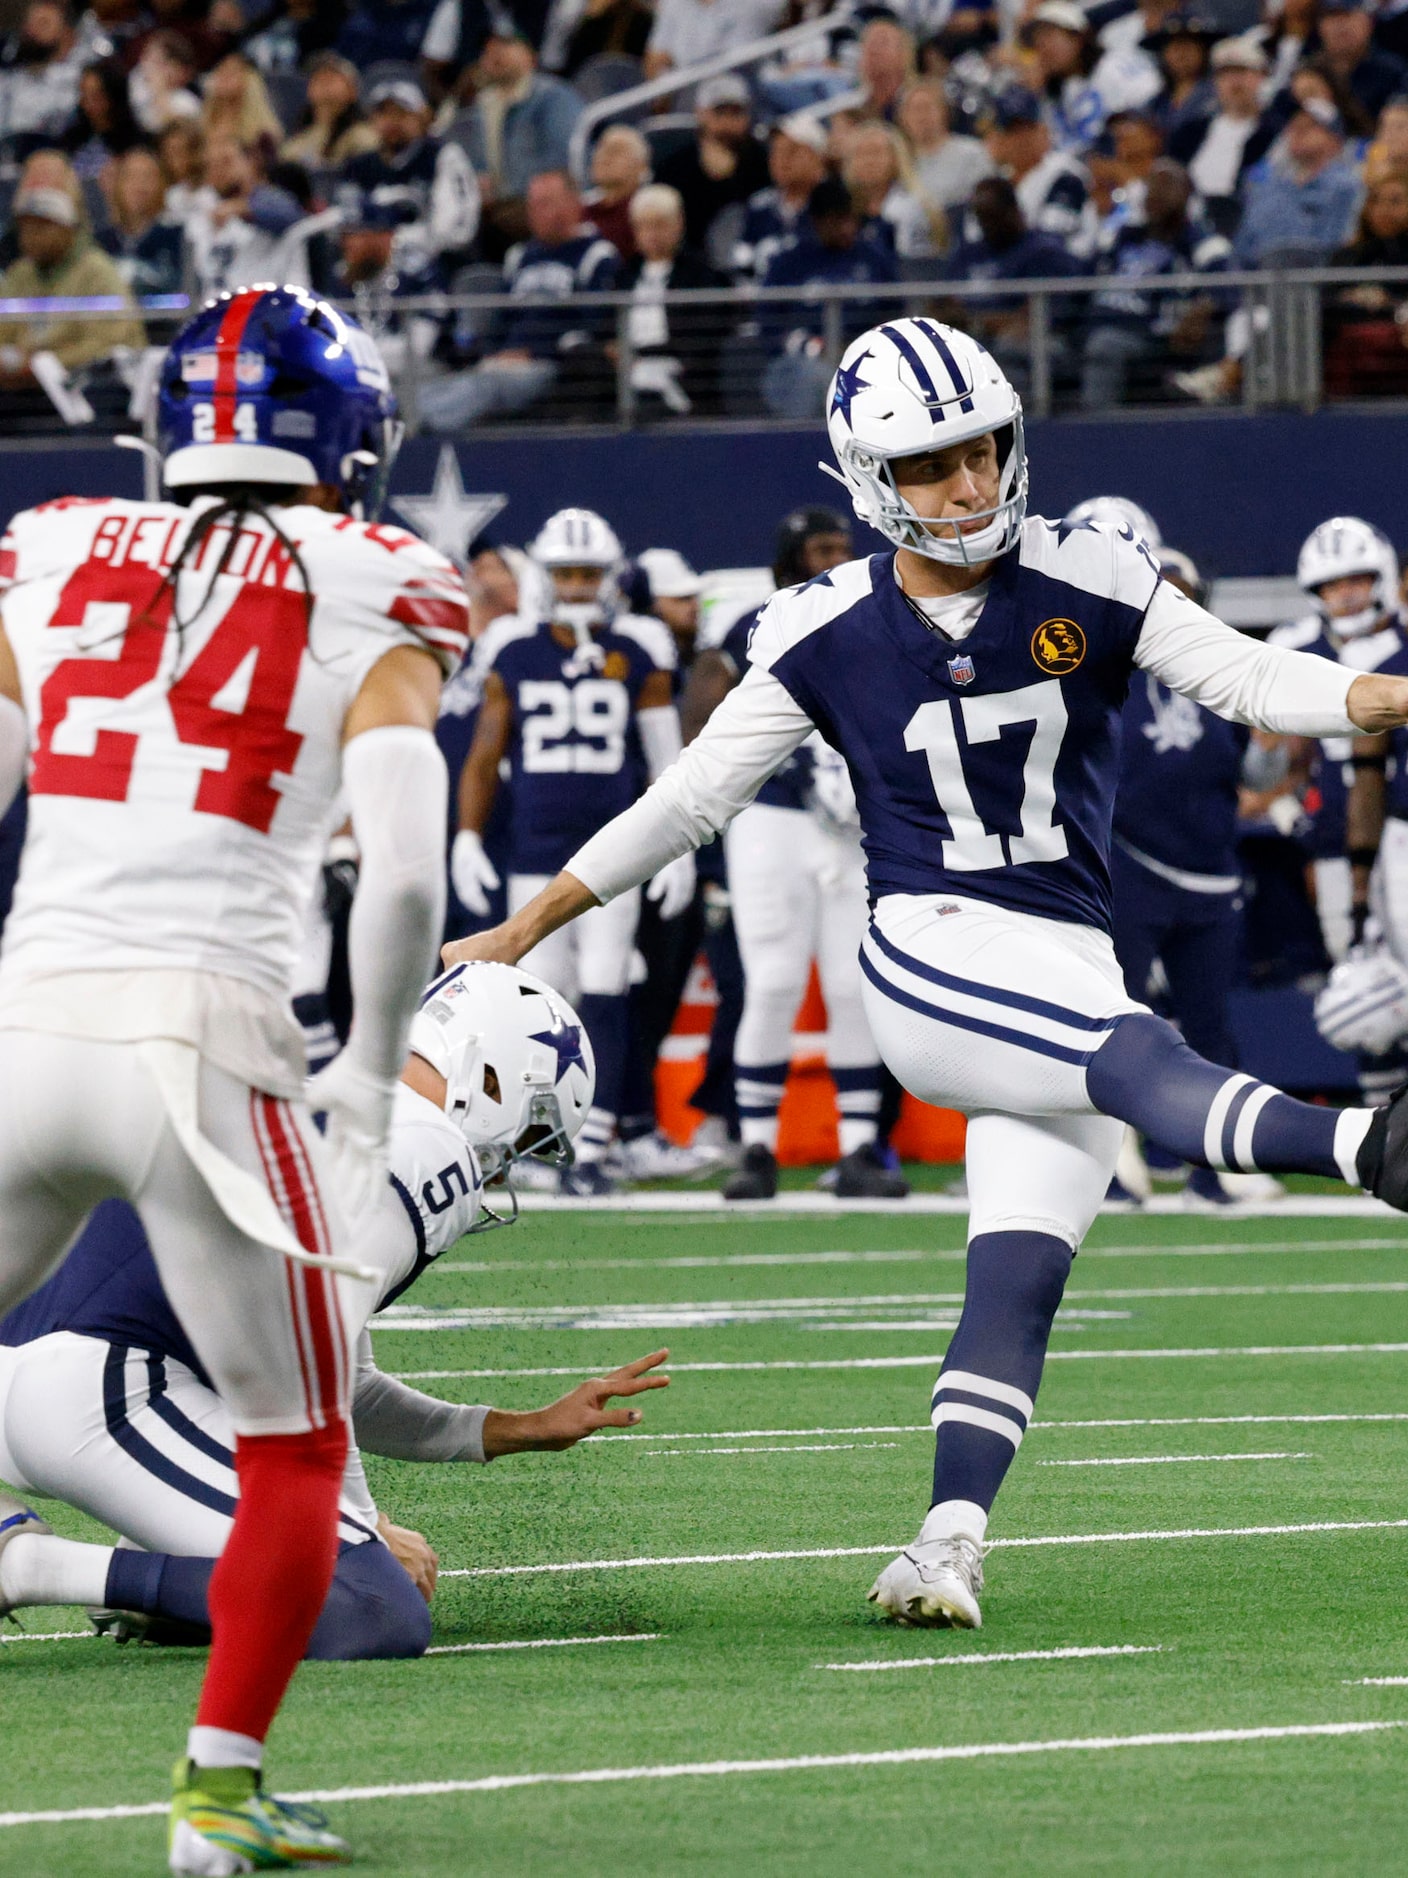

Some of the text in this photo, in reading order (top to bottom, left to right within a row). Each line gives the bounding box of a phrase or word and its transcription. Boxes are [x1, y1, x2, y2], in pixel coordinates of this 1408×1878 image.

[192, 402, 258, 443] 24
[27, 560, 314, 835] 24
[518, 679, 629, 774] 29
[903, 678, 1069, 871] 17
